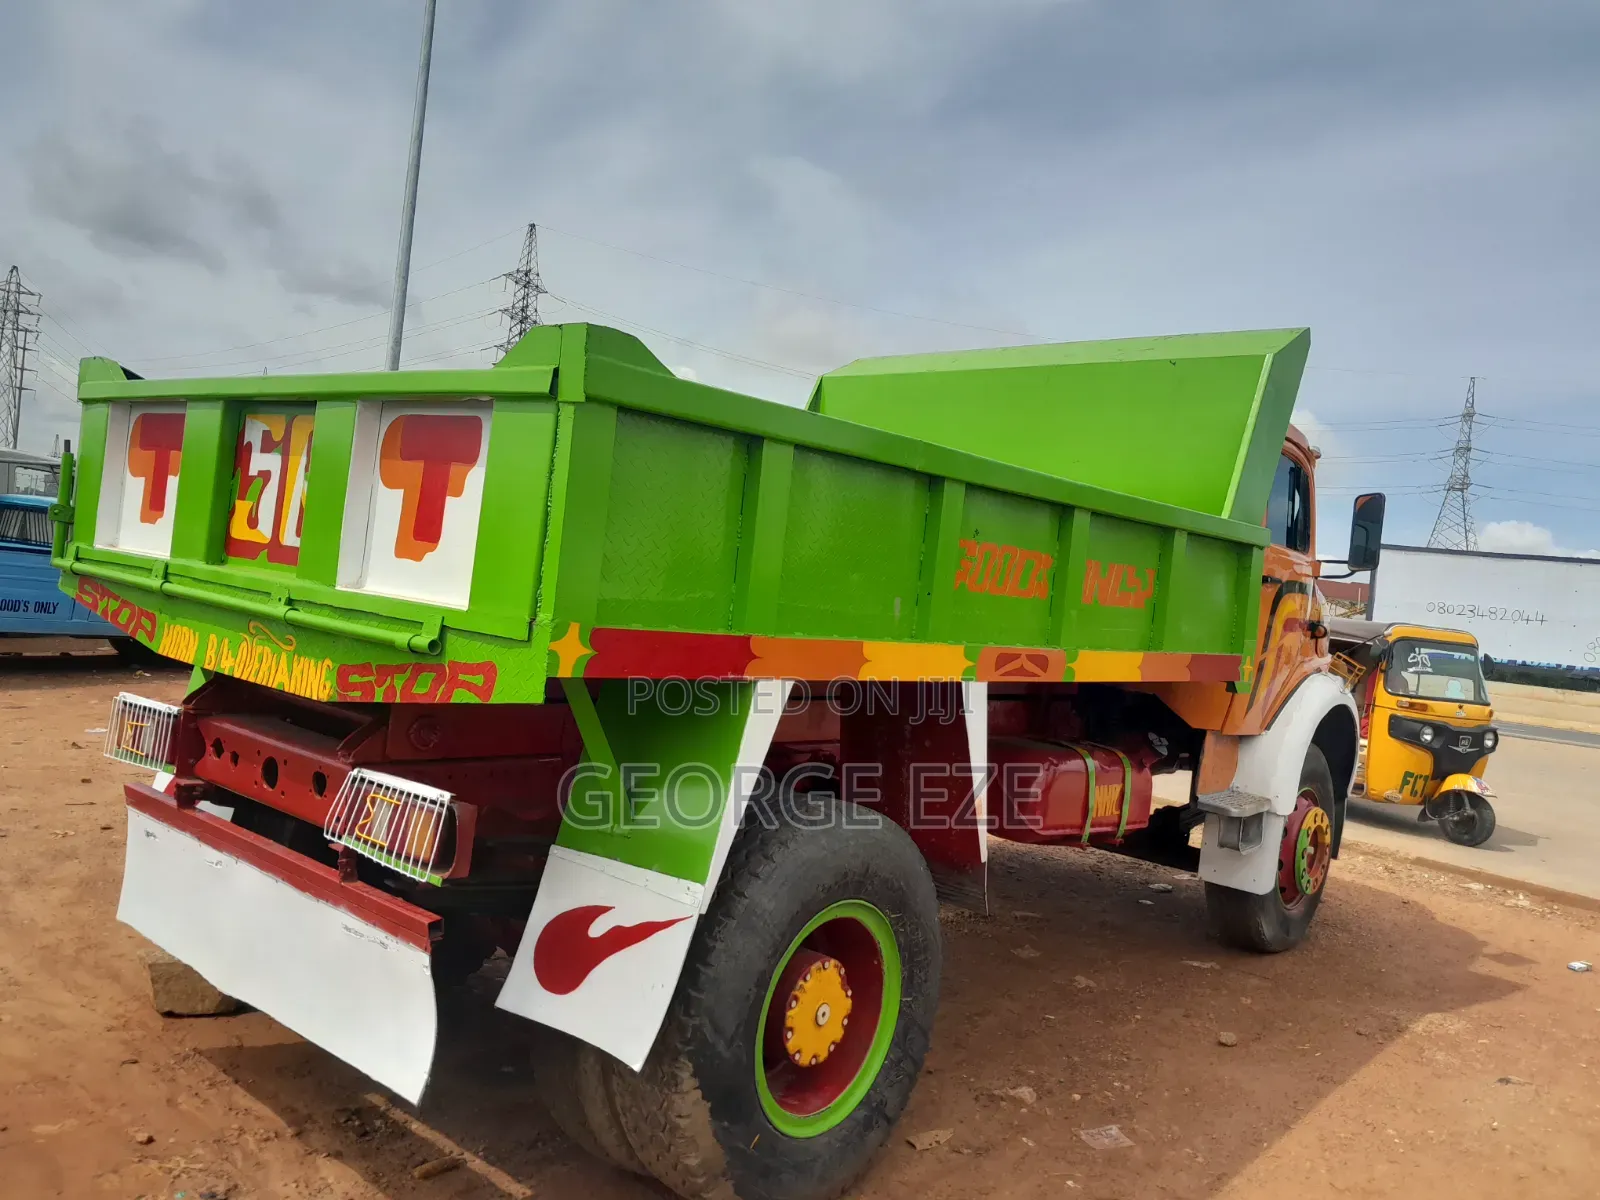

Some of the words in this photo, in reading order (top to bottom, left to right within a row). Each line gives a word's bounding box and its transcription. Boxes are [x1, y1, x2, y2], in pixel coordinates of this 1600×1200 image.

[380, 415, 482, 562] T
[1082, 559, 1155, 609] NLY
[34, 600, 60, 615] ONLY
[76, 577, 158, 643] STOP
[1426, 601, 1548, 626] 08023482044
[157, 622, 199, 665] HORN
[336, 660, 498, 703] STOP
